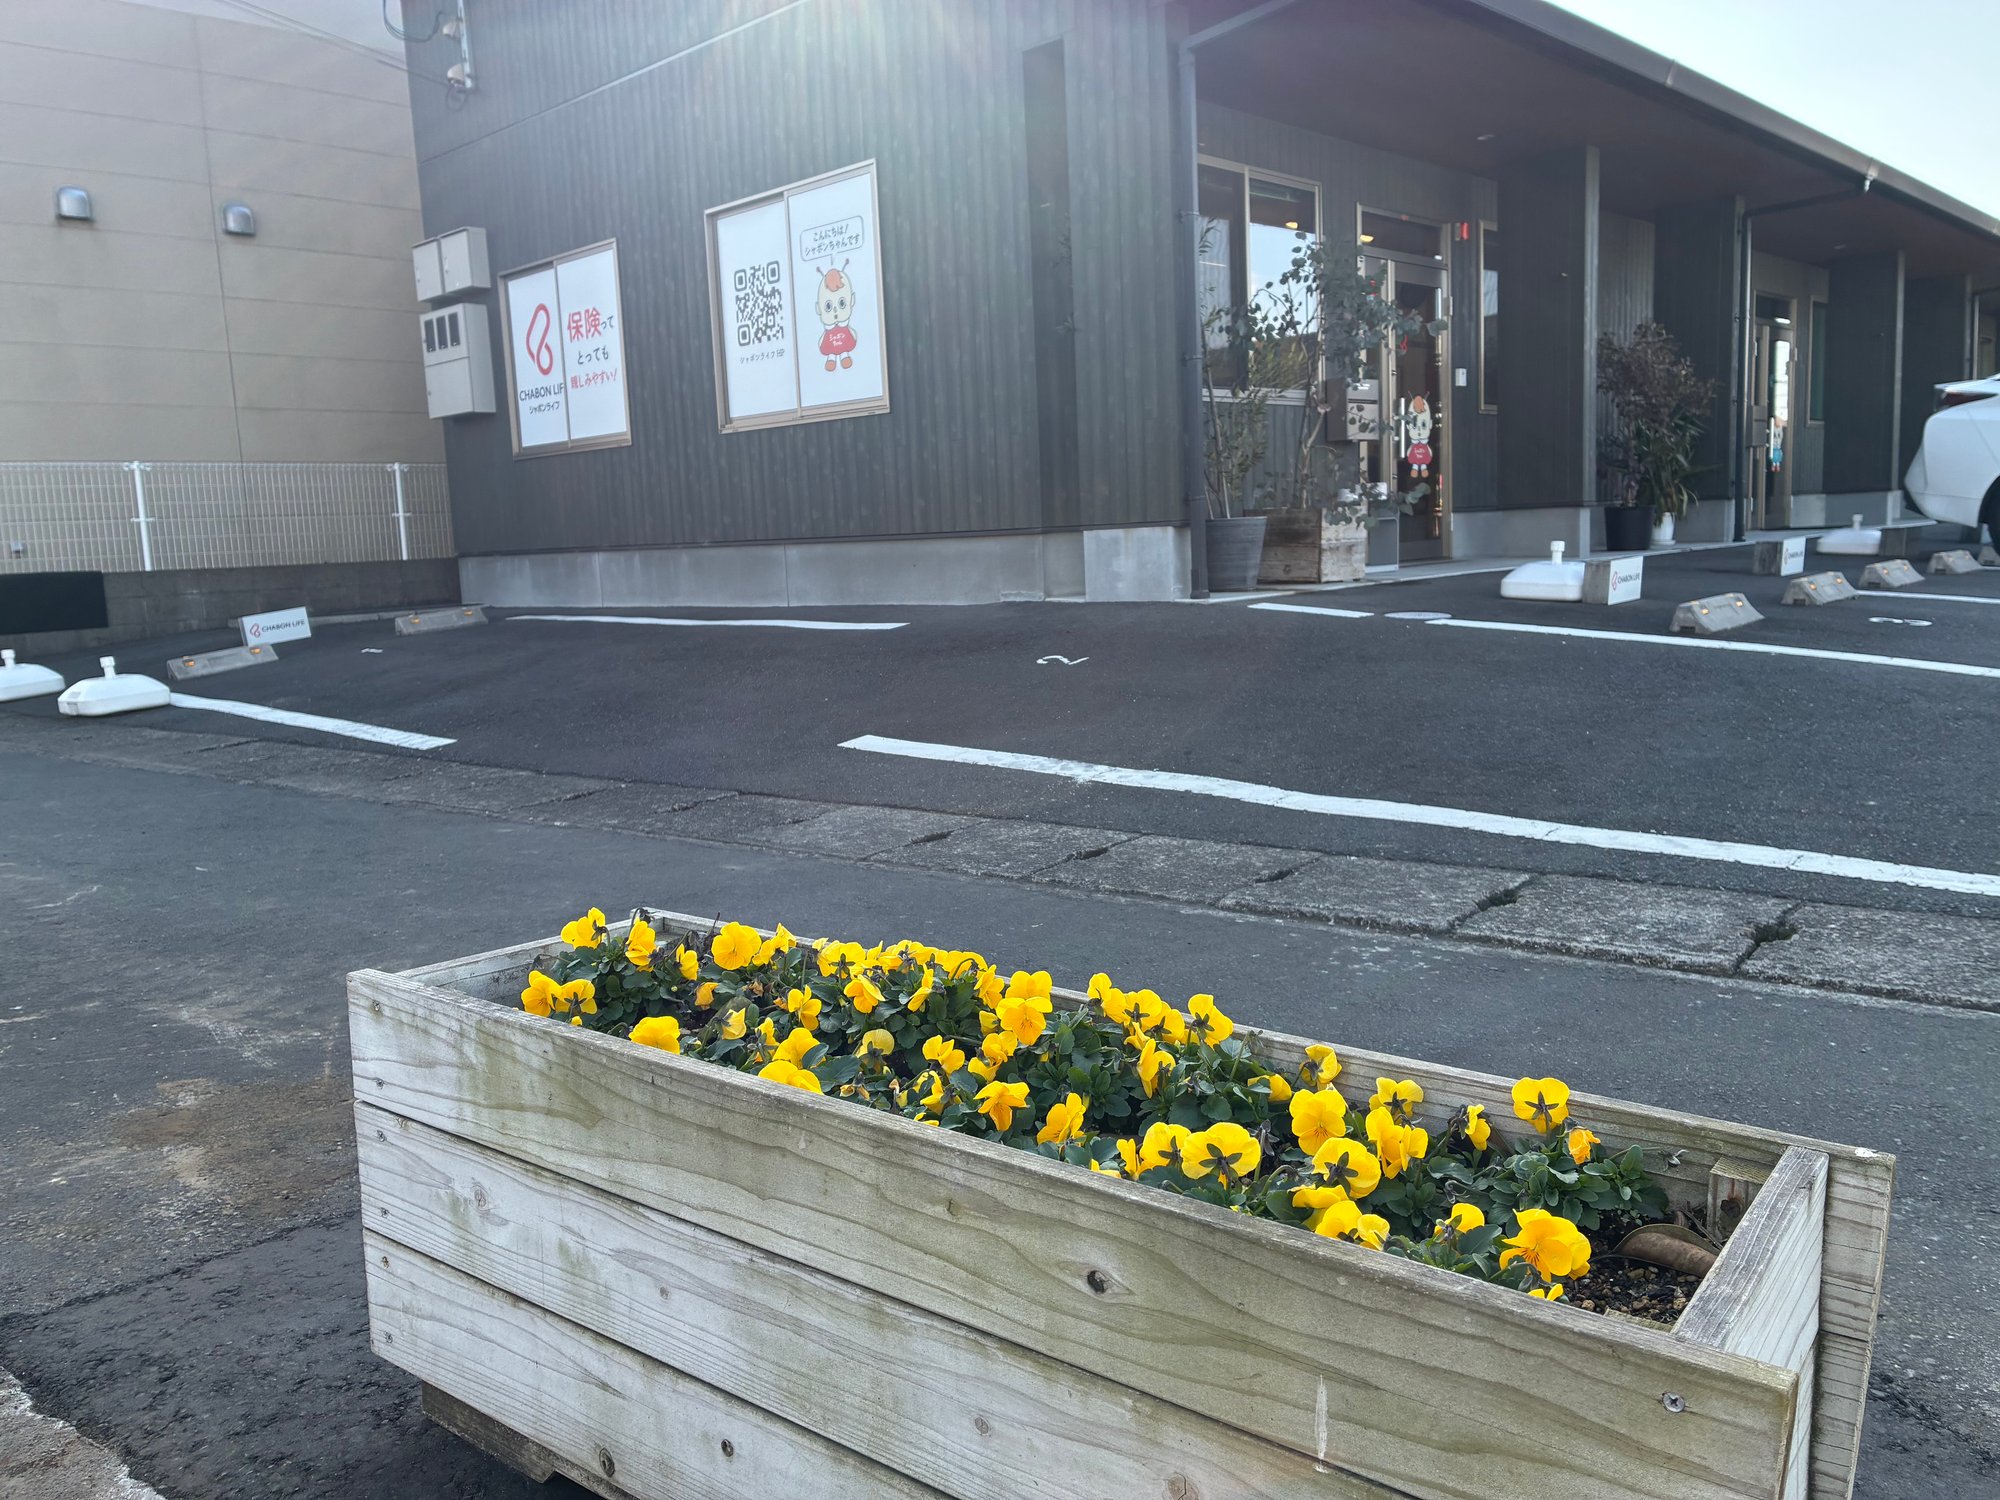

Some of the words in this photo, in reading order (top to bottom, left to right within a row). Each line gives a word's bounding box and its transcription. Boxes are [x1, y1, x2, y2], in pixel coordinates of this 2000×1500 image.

[567, 306, 614, 343] 保険って
[577, 345, 609, 365] とっても
[519, 386, 552, 402] CHABON
[291, 619, 305, 627] LIFE
